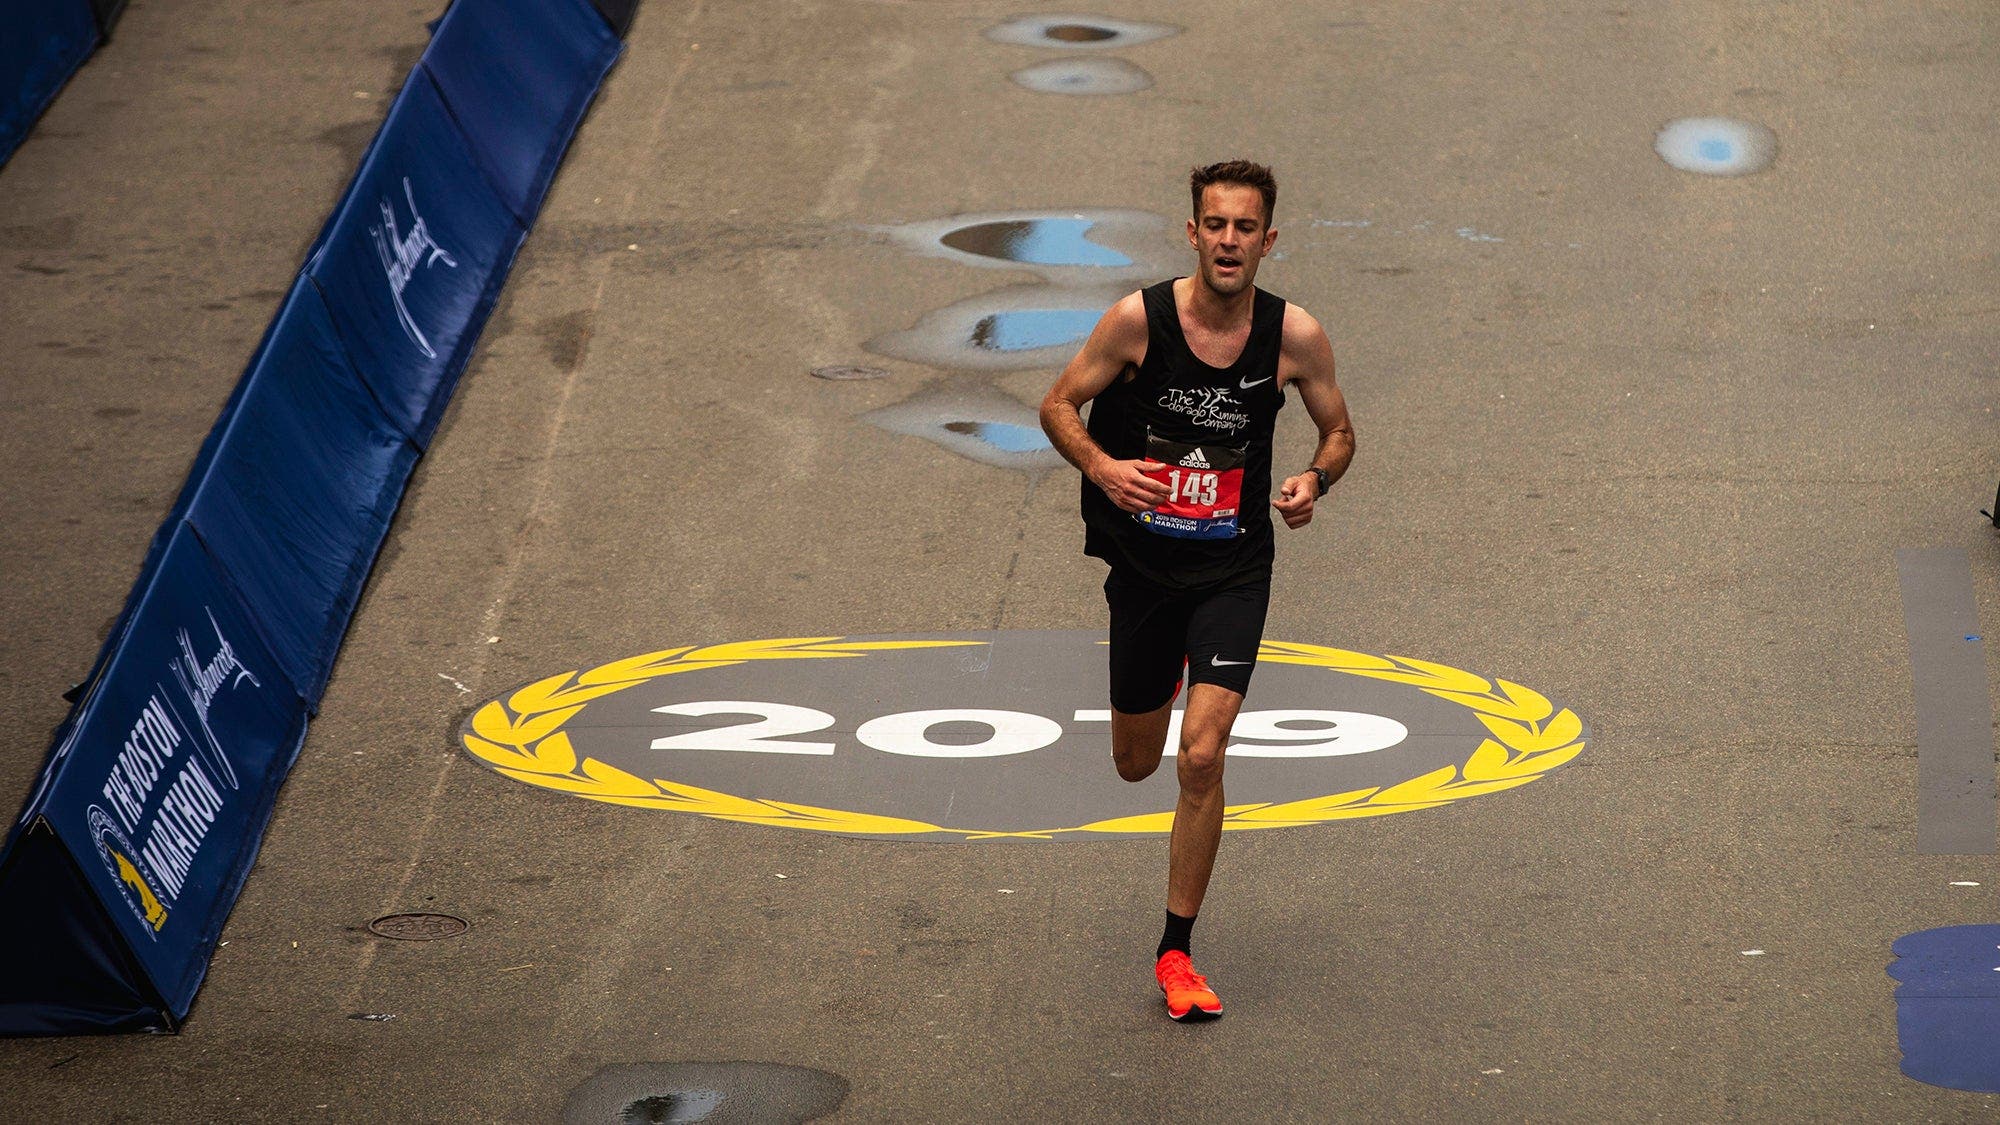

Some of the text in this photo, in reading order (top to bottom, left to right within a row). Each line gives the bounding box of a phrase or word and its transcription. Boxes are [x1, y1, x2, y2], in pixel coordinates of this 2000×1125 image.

[1168, 388, 1195, 406] The
[1158, 396, 1250, 429] Colorado Running
[1192, 415, 1237, 436] Company
[1179, 459, 1211, 470] adidas
[1168, 469, 1219, 506] 143
[1154, 520, 1198, 532] MARATHON
[1169, 516, 1198, 526] BOSTON
[118, 694, 182, 804] BOSTON
[103, 764, 143, 835] THE
[142, 755, 224, 901] MARATHON
